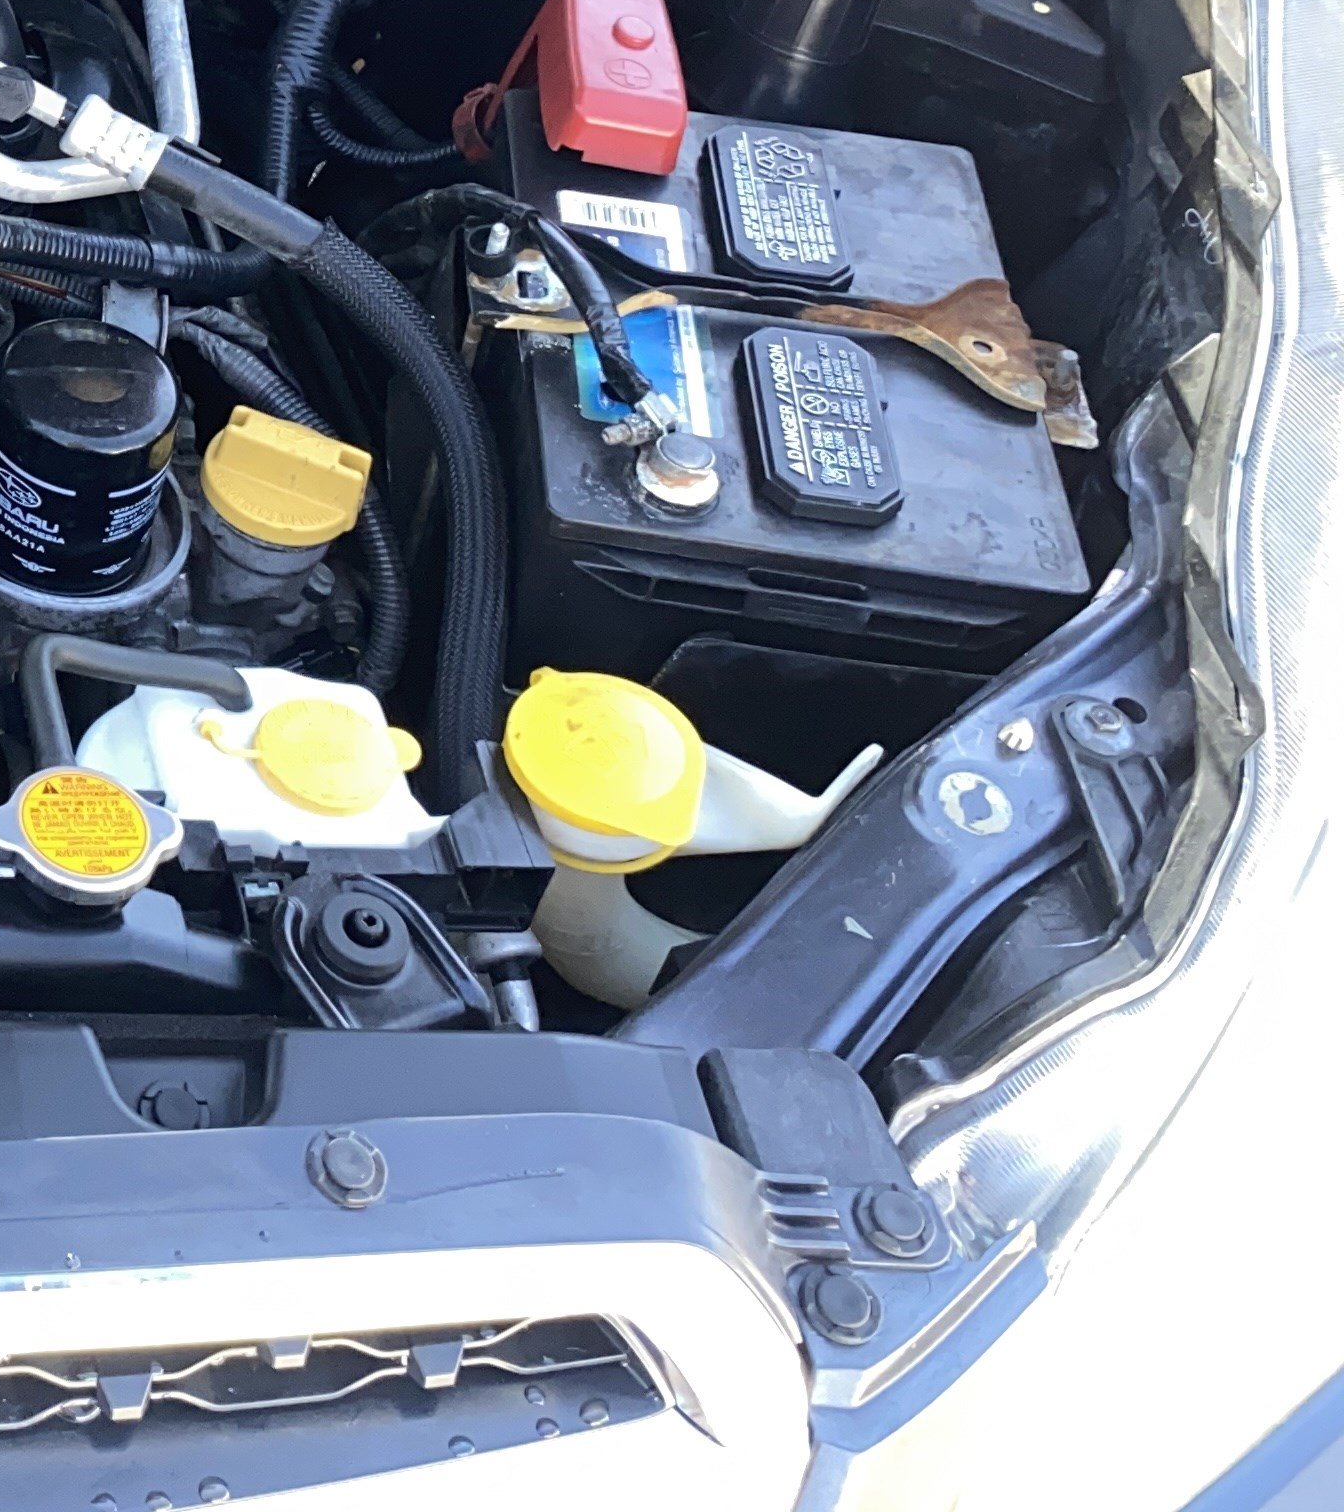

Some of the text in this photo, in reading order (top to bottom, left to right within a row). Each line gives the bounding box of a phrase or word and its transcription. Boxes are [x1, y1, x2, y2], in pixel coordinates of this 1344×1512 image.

[768, 343, 792, 393] POISON
[830, 401, 841, 415] NO
[779, 404, 805, 460] DANGER
[848, 445, 861, 469] GASES
[4, 512, 66, 545] INDONESIA
[55, 848, 130, 857] AVERTISSEMENT
